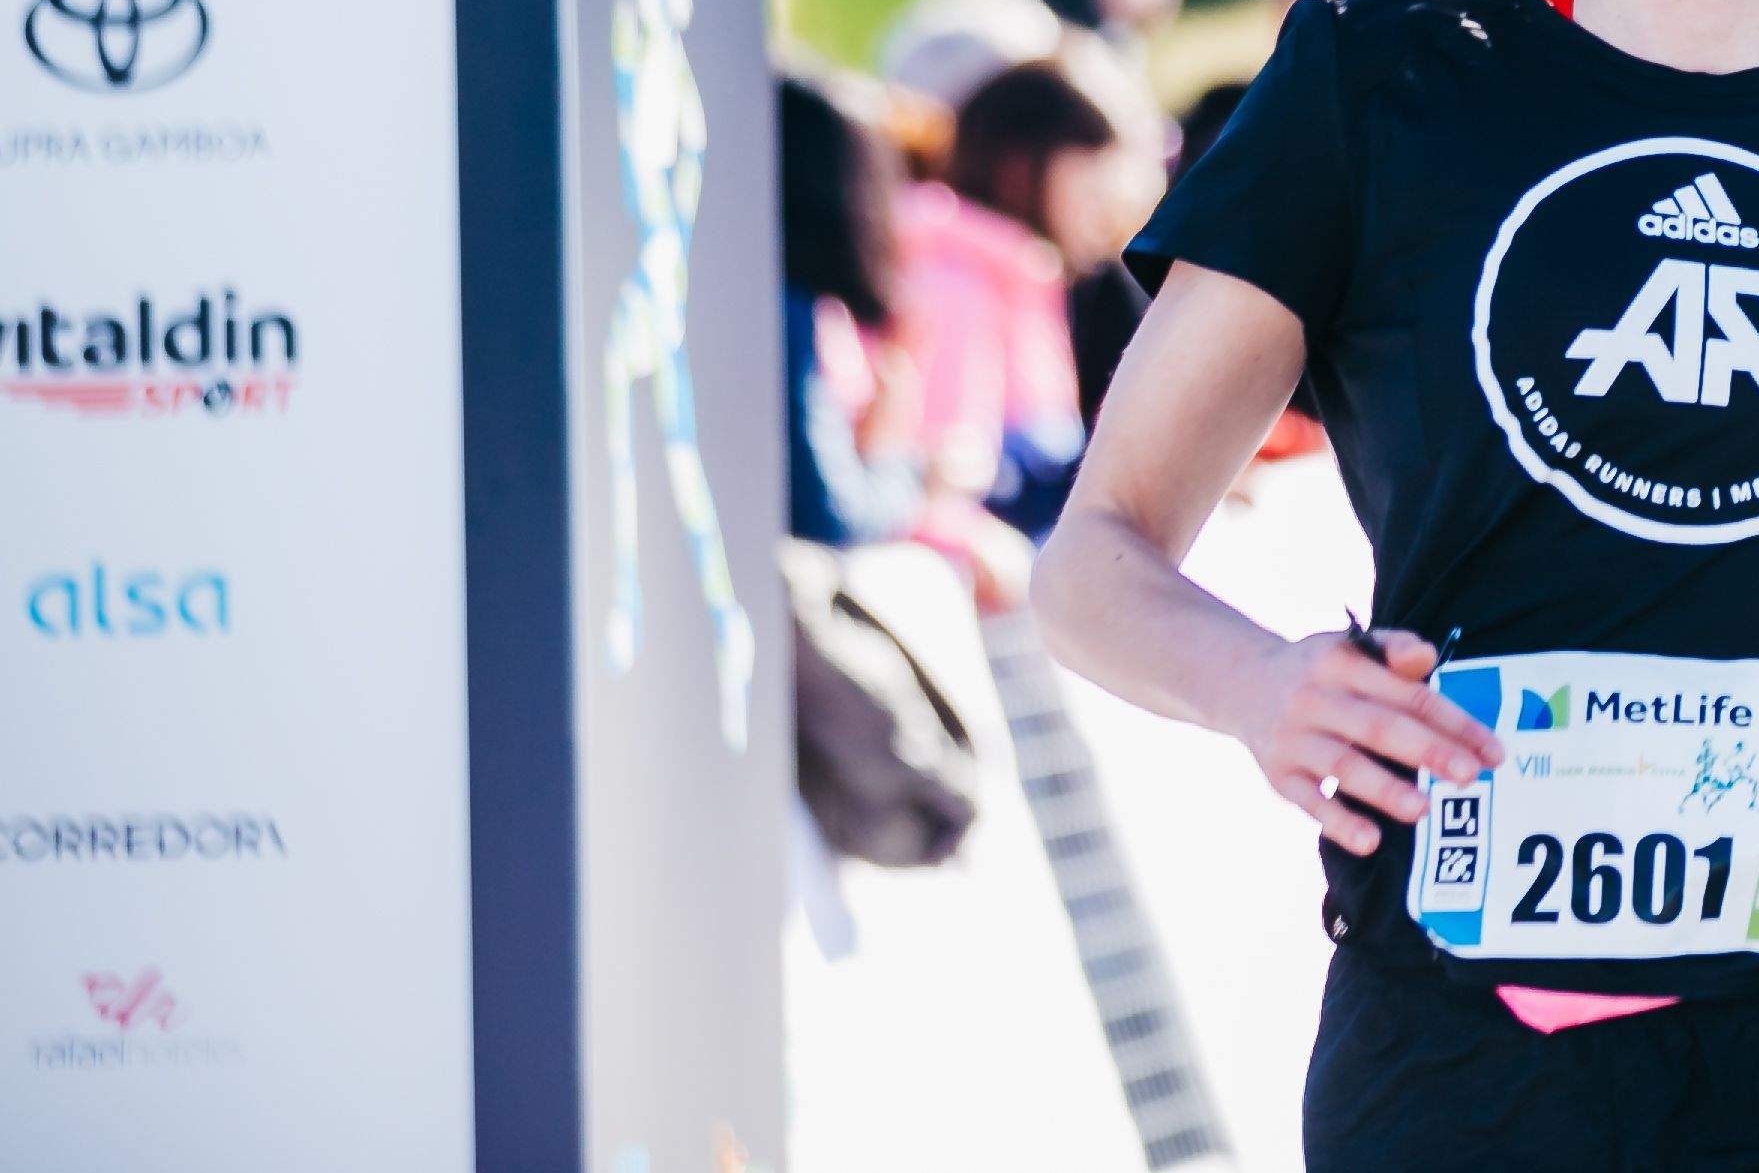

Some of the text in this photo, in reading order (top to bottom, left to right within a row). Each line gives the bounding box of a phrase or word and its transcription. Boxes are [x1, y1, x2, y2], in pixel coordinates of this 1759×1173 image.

[1638, 212, 1759, 249] adidas
[0, 289, 297, 370] italdin
[1516, 377, 1582, 459] ADIDAS
[1585, 453, 1701, 508] RUNNERS
[25, 564, 232, 637] alsa
[1585, 690, 1753, 727] MetLife
[1515, 753, 1552, 779] VIII
[0, 813, 288, 864] ORREDORA
[1510, 831, 1734, 926] 2601
